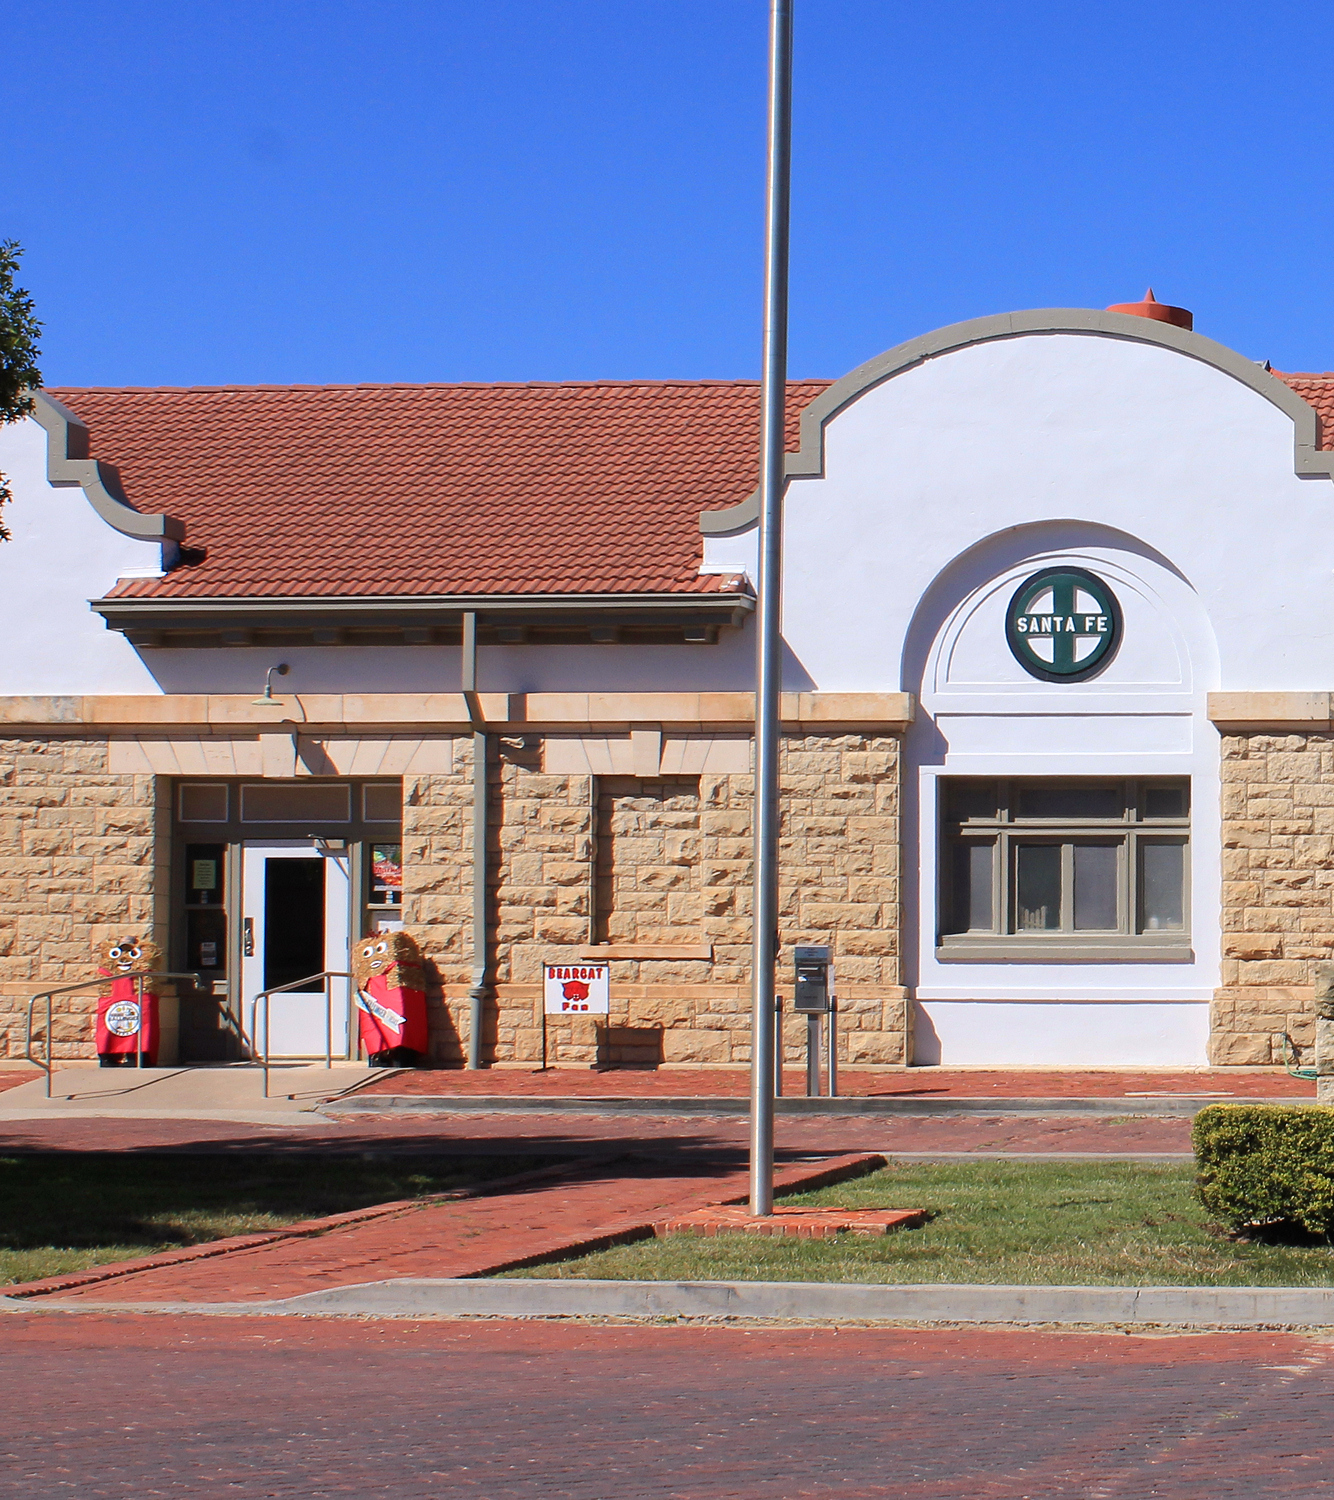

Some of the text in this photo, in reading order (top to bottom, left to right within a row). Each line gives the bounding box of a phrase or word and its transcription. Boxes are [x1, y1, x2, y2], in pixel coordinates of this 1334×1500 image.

[1017, 616, 1108, 633] SANTA FE
[548, 967, 603, 980] BEARCAT
